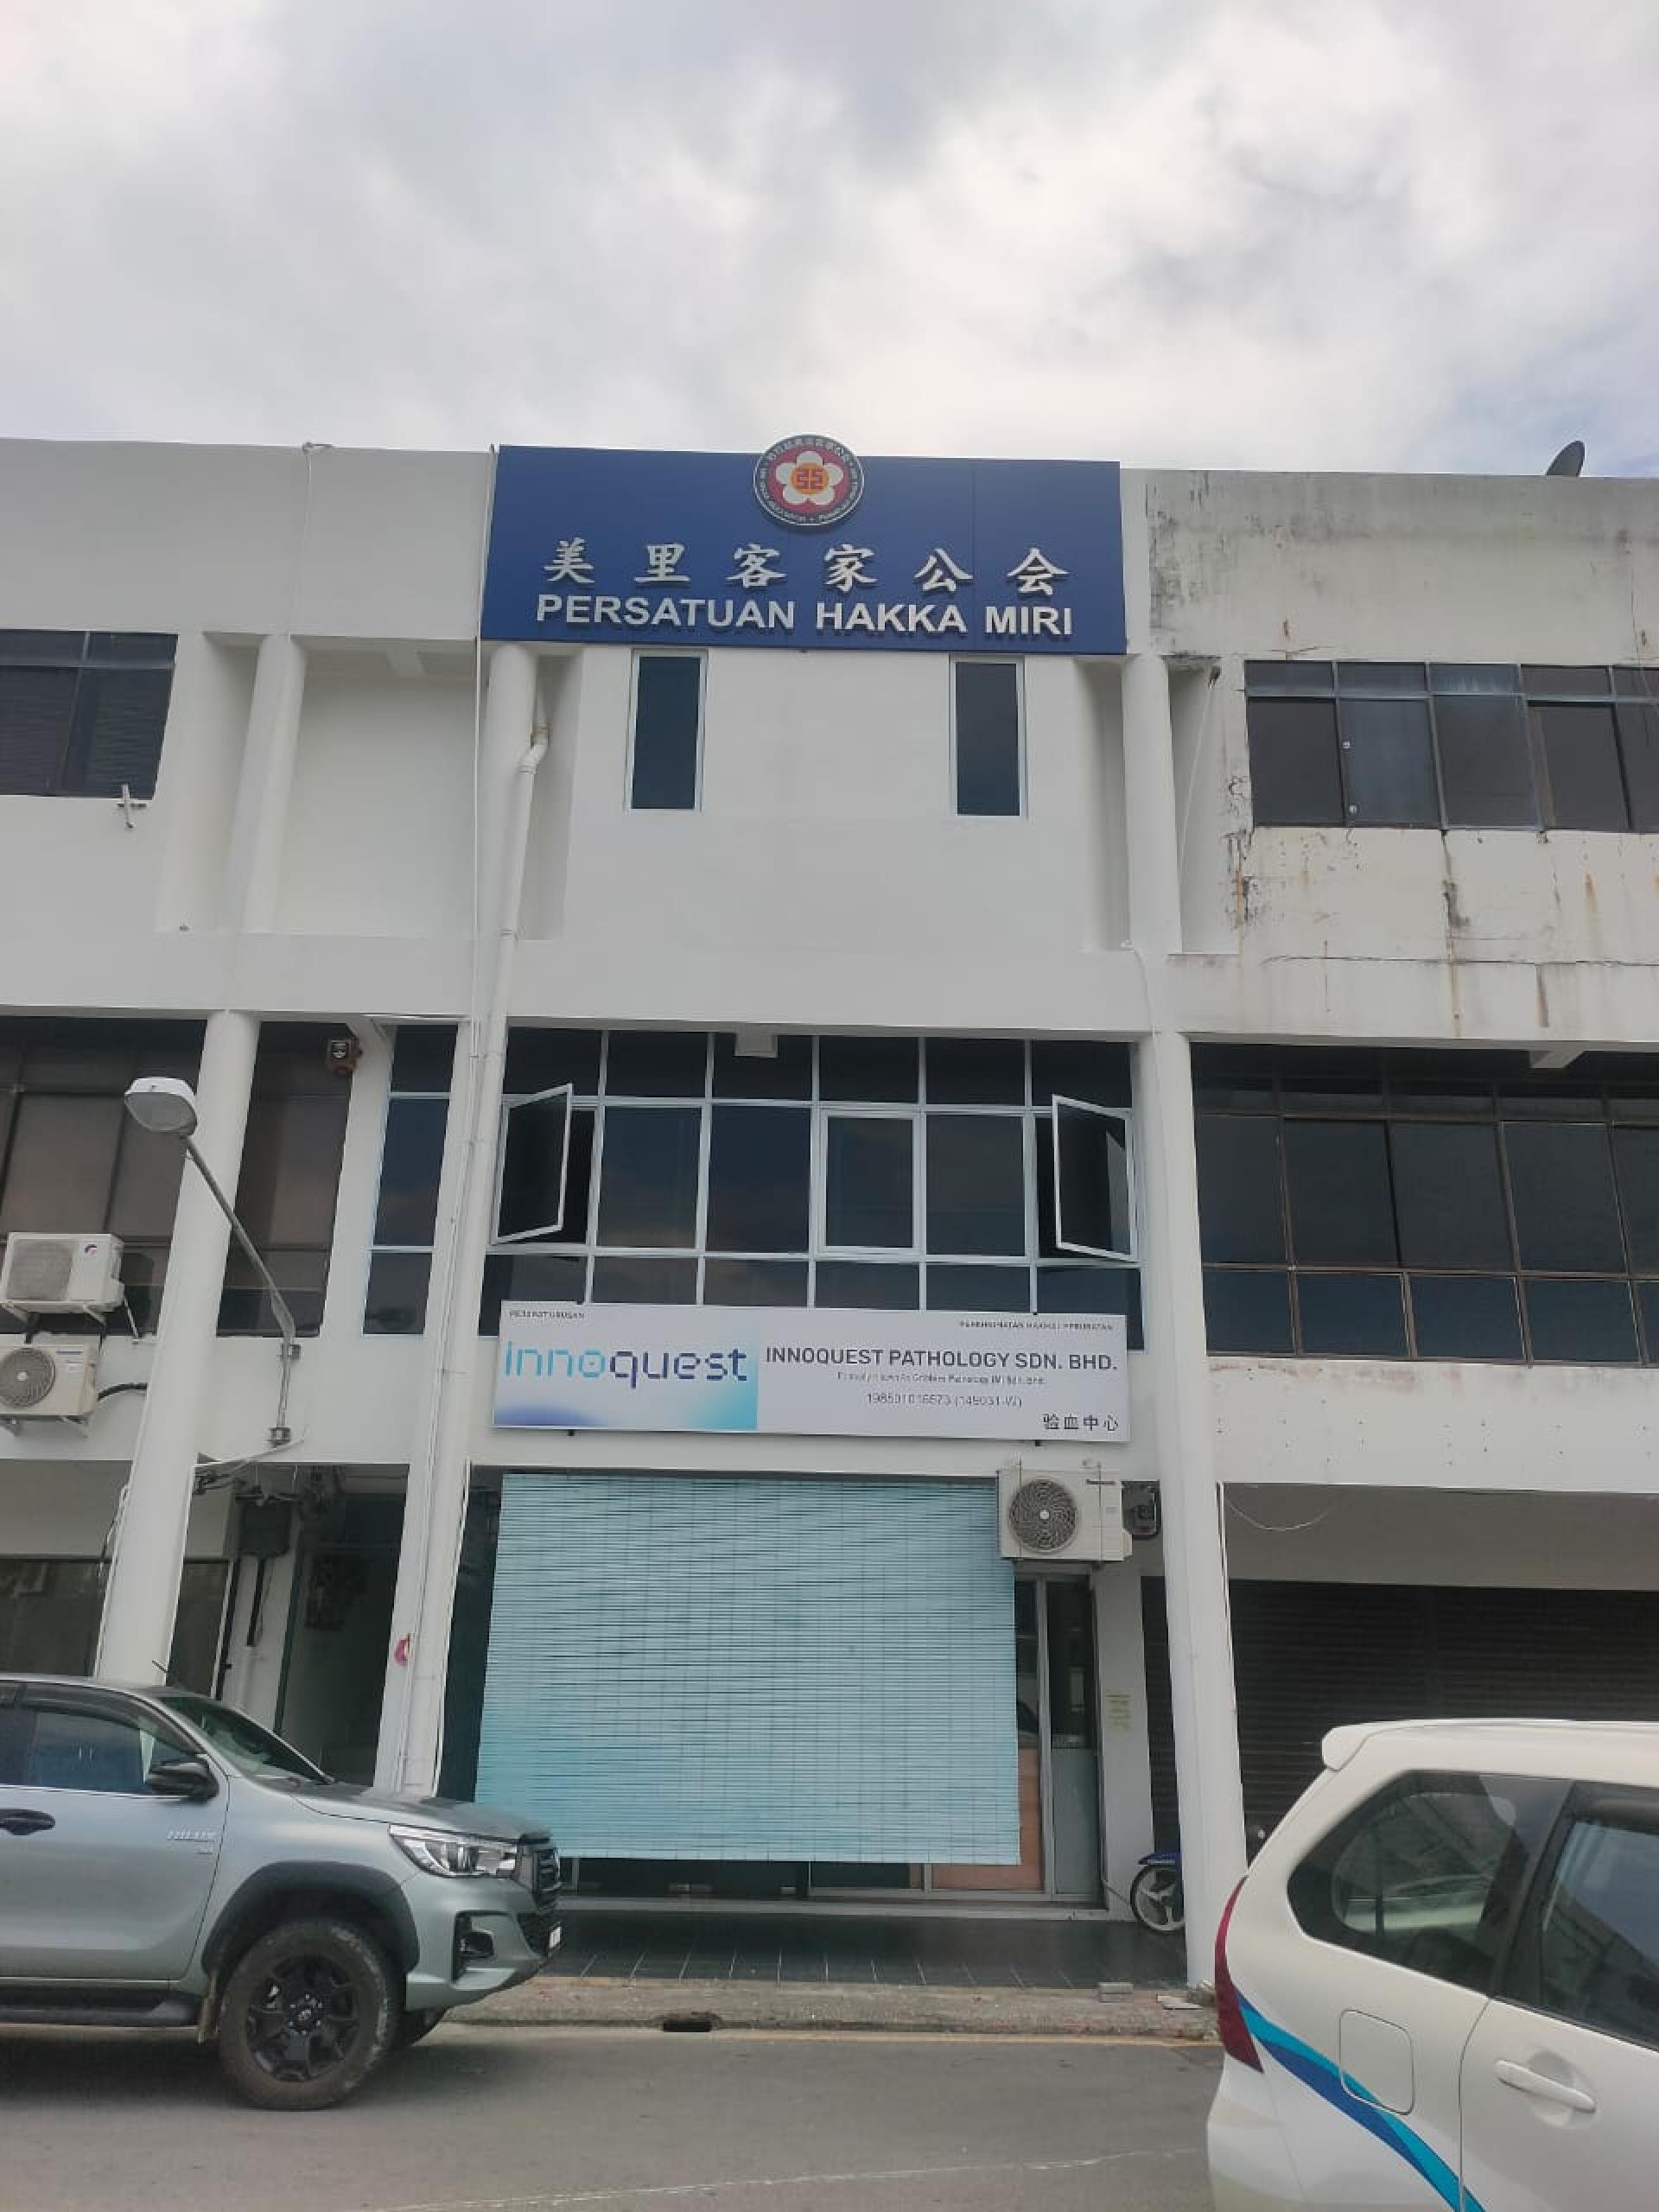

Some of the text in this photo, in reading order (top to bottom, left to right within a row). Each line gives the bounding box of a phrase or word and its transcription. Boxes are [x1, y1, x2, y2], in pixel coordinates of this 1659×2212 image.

[543, 537, 1070, 595] 美里客家公会
[537, 594, 1072, 635] PERSATUAN HAKKA MIRI
[766, 1346, 1118, 1370] INNOQUEST PATHOLOGY SDN. BHD.
[1043, 1413, 1119, 1432] 验血中心
